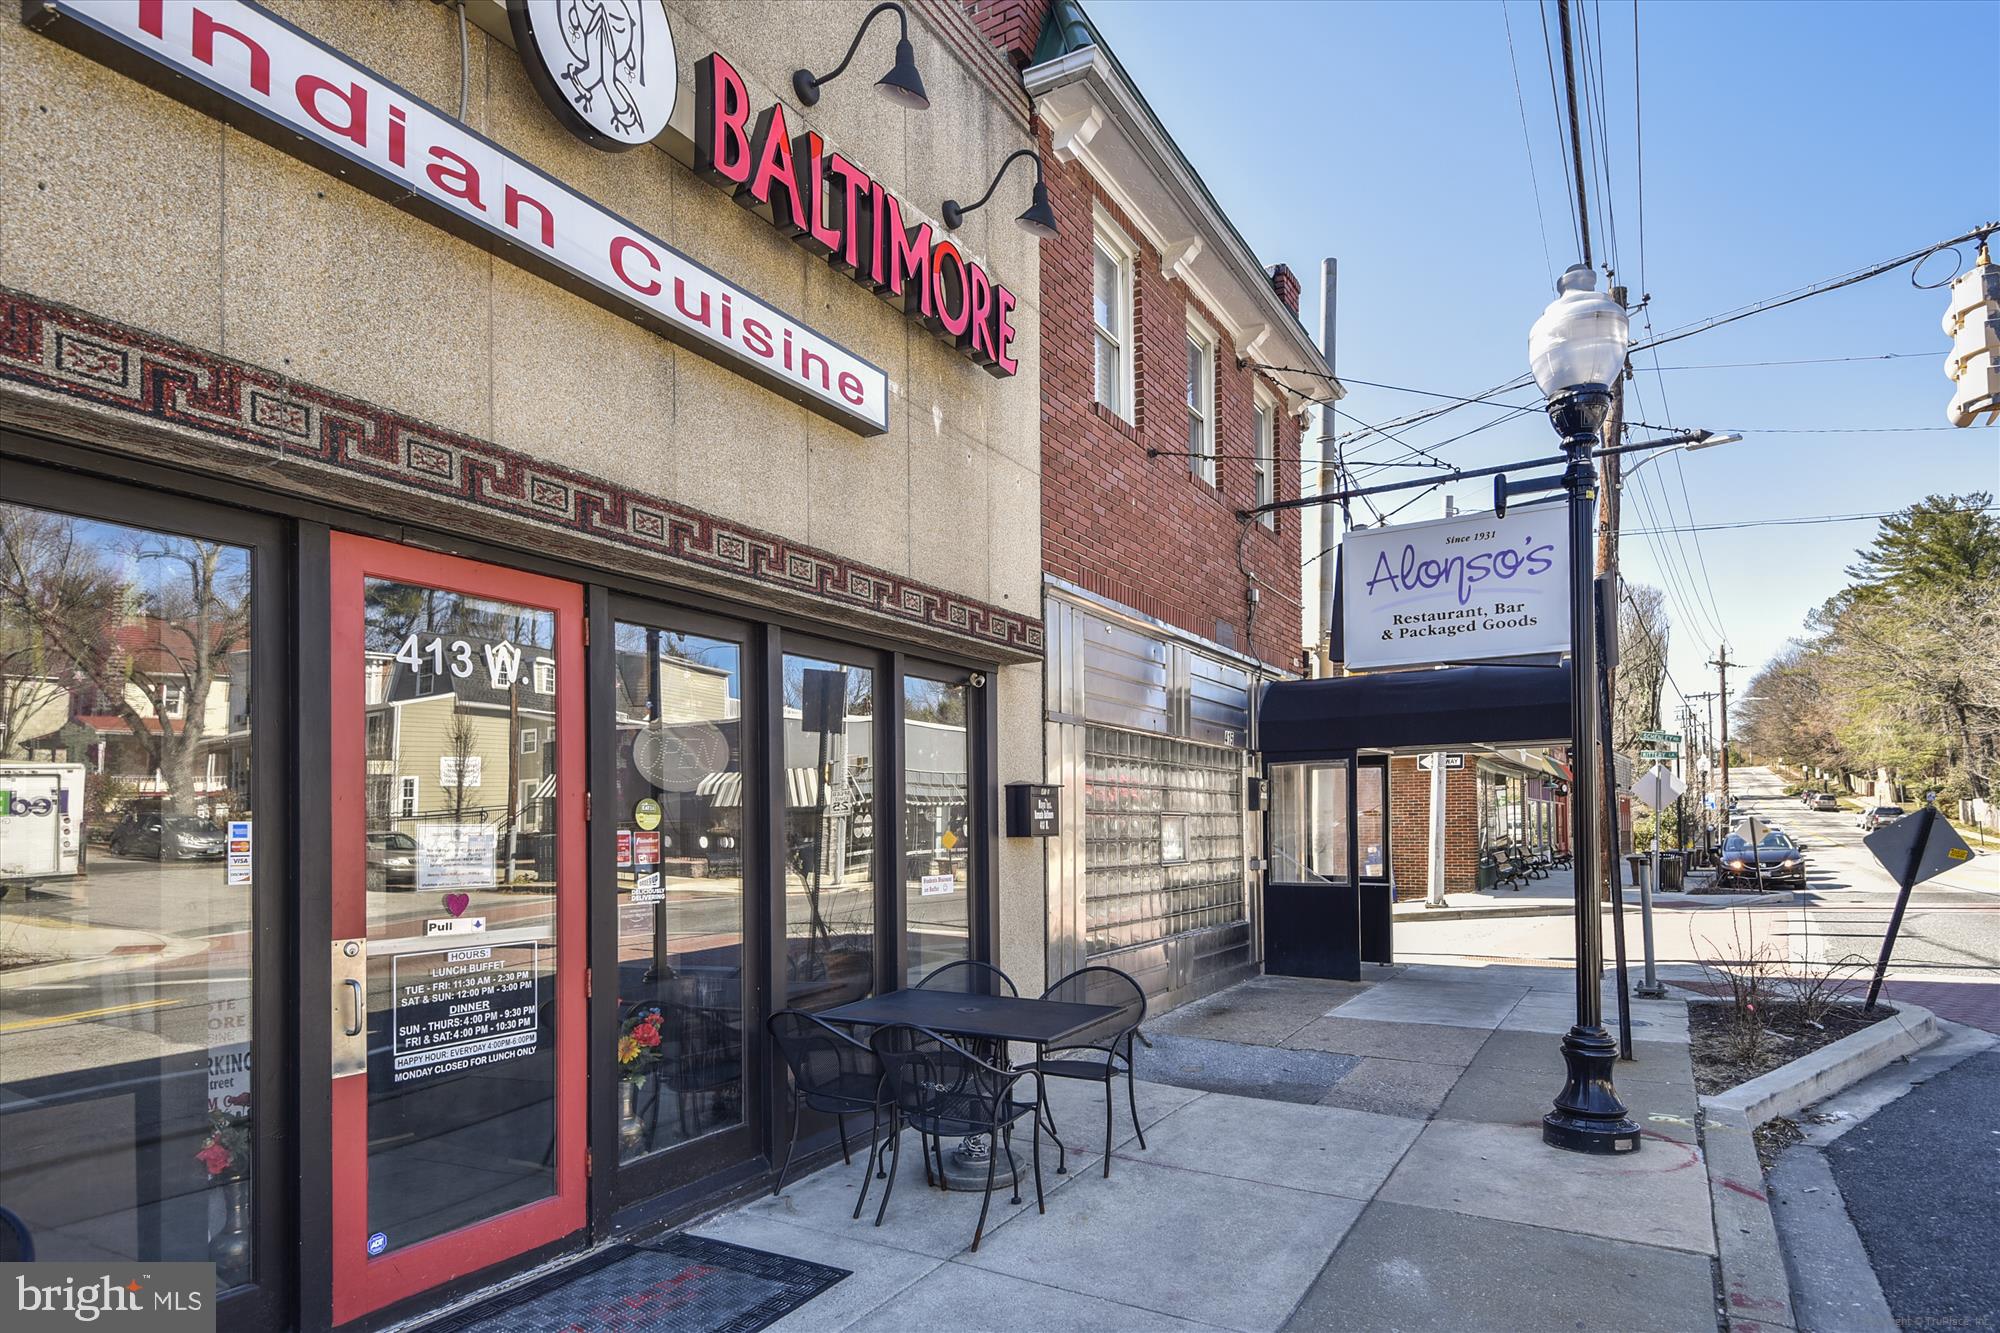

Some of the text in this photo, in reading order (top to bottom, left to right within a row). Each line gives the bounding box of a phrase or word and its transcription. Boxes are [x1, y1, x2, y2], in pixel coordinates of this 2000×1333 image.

[708, 51, 1018, 377] BALTIMORE
[609, 236, 865, 406] Cuisine
[1446, 530, 1496, 545] Since 1931
[1366, 535, 1555, 605] Alonso's
[1392, 602, 1526, 626] Restaurant, Bar
[1381, 614, 1538, 641] & Packaged Goods
[396, 633, 474, 678] 413
[429, 922, 453, 932] Pull
[451, 949, 490, 961] HOURS:
[432, 960, 506, 978] LUNCH BUFFET
[401, 996, 421, 1007] SAT
[422, 995, 430, 1004] &
[431, 991, 455, 1003] SUN:
[456, 987, 480, 999] 12:00
[481, 985, 495, 996] PM
[501, 982, 518, 993] 3:00
[520, 981, 532, 990] PM
[405, 984, 425, 996] TUE
[432, 982, 451, 993] FRI:
[453, 978, 475, 989] 11:30
[476, 976, 491, 985] AM
[497, 973, 515, 983] 2:30
[516, 970, 529, 980] PM
[399, 1026, 420, 1037] SUN
[428, 1018, 463, 1032] THURS:
[463, 1015, 483, 1027] 4:00
[484, 1011, 498, 1022] PM
[504, 1008, 522, 1018] 9:30
[523, 1004, 536, 1015] PM
[449, 1000, 491, 1015] DINNER
[405, 1037, 422, 1048] FRI
[423, 1035, 430, 1044] &
[432, 1031, 453, 1043] SAT:
[453, 1027, 474, 1039] 4:00
[475, 1024, 489, 1035] PM
[496, 1019, 517, 1031] 10:30
[518, 1017, 531, 1027] PM
[394, 1045, 537, 1082] MONDAY CLOSED FOR LUNCH ONLY
[397, 1056, 425, 1067] HAPPY
[425, 1051, 449, 1062] HOUR:
[450, 1043, 487, 1056] EVERYDAY
